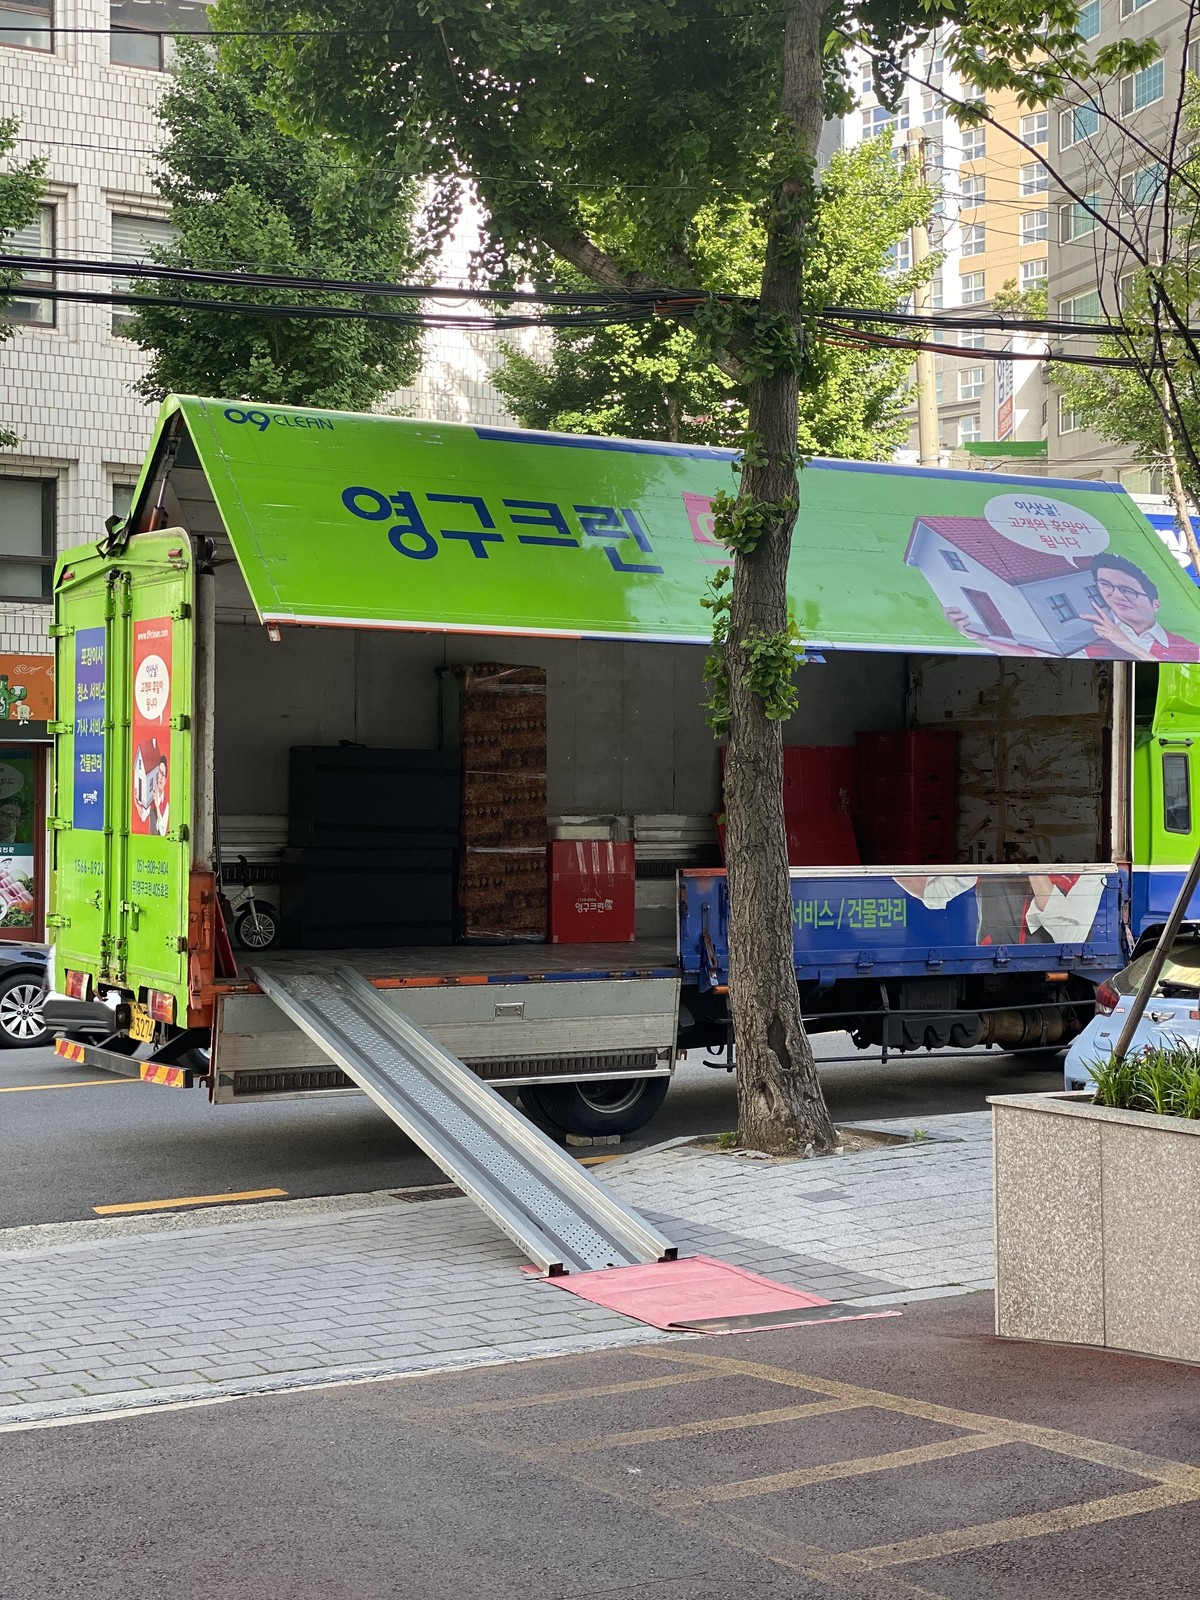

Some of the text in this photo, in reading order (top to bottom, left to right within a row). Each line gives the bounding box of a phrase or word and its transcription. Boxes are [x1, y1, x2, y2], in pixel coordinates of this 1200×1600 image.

[273, 414, 334, 430] CLEAN
[1014, 501, 1061, 517] 이삿날!
[341, 486, 664, 574] 영구크린
[1008, 517, 1091, 534] 고객의 휴일이
[1039, 534, 1081, 549] 됩니다
[80, 646, 104, 666] 포장이사
[77, 682, 105, 702] 청소 서비스
[77, 718, 105, 737] 가사 서비스
[80, 753, 102, 773] 건물관리
[74, 859, 104, 875] 1566-0924
[574, 902, 604, 913] 영구크린
